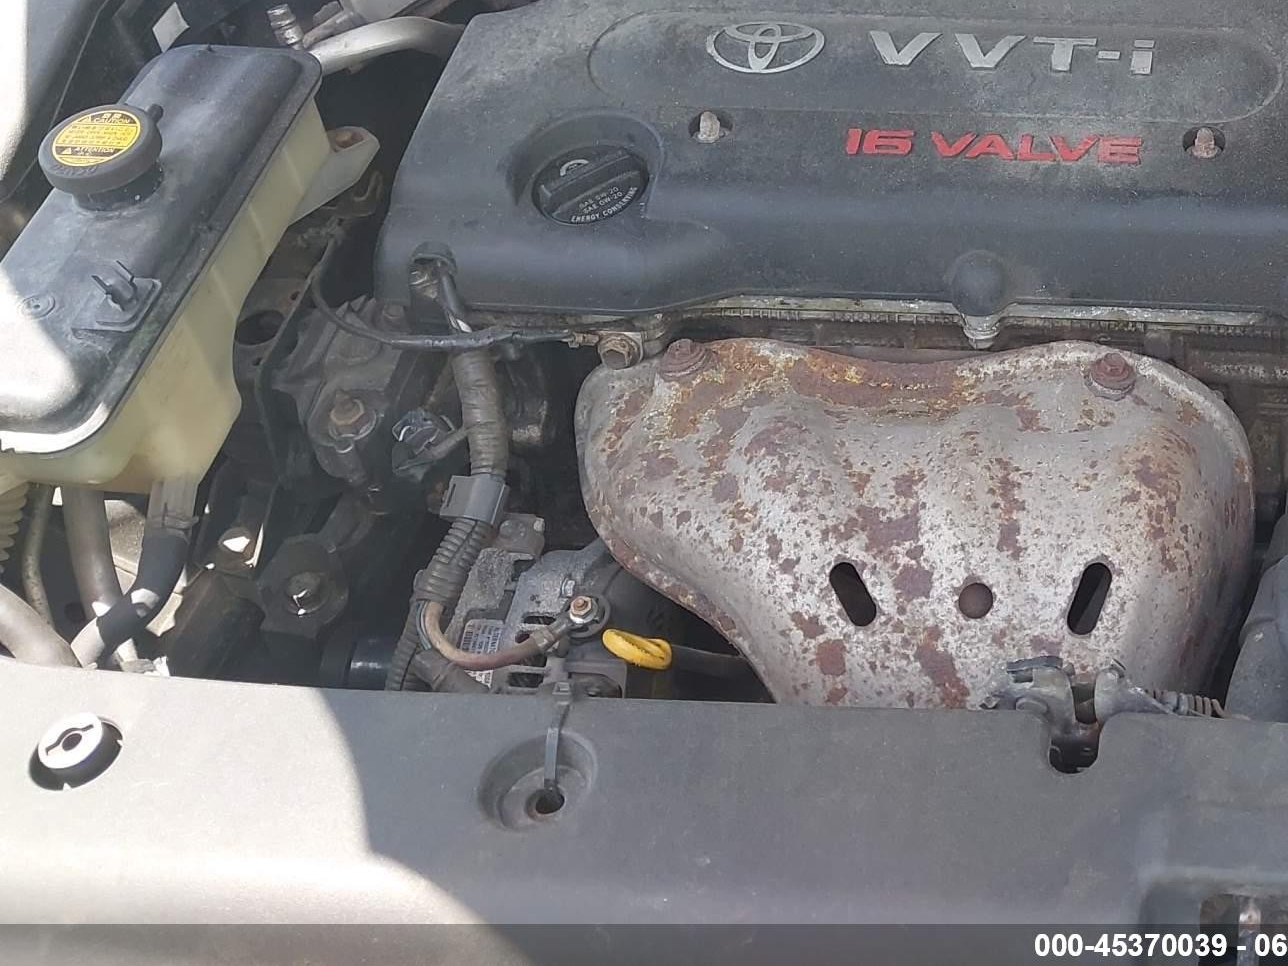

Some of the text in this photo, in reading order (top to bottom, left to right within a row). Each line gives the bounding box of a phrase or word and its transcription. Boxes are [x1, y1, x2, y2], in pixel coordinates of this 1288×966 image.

[845, 128, 1143, 164] 16 VALVE
[571, 187, 638, 222] ENERGY CONSERVING
